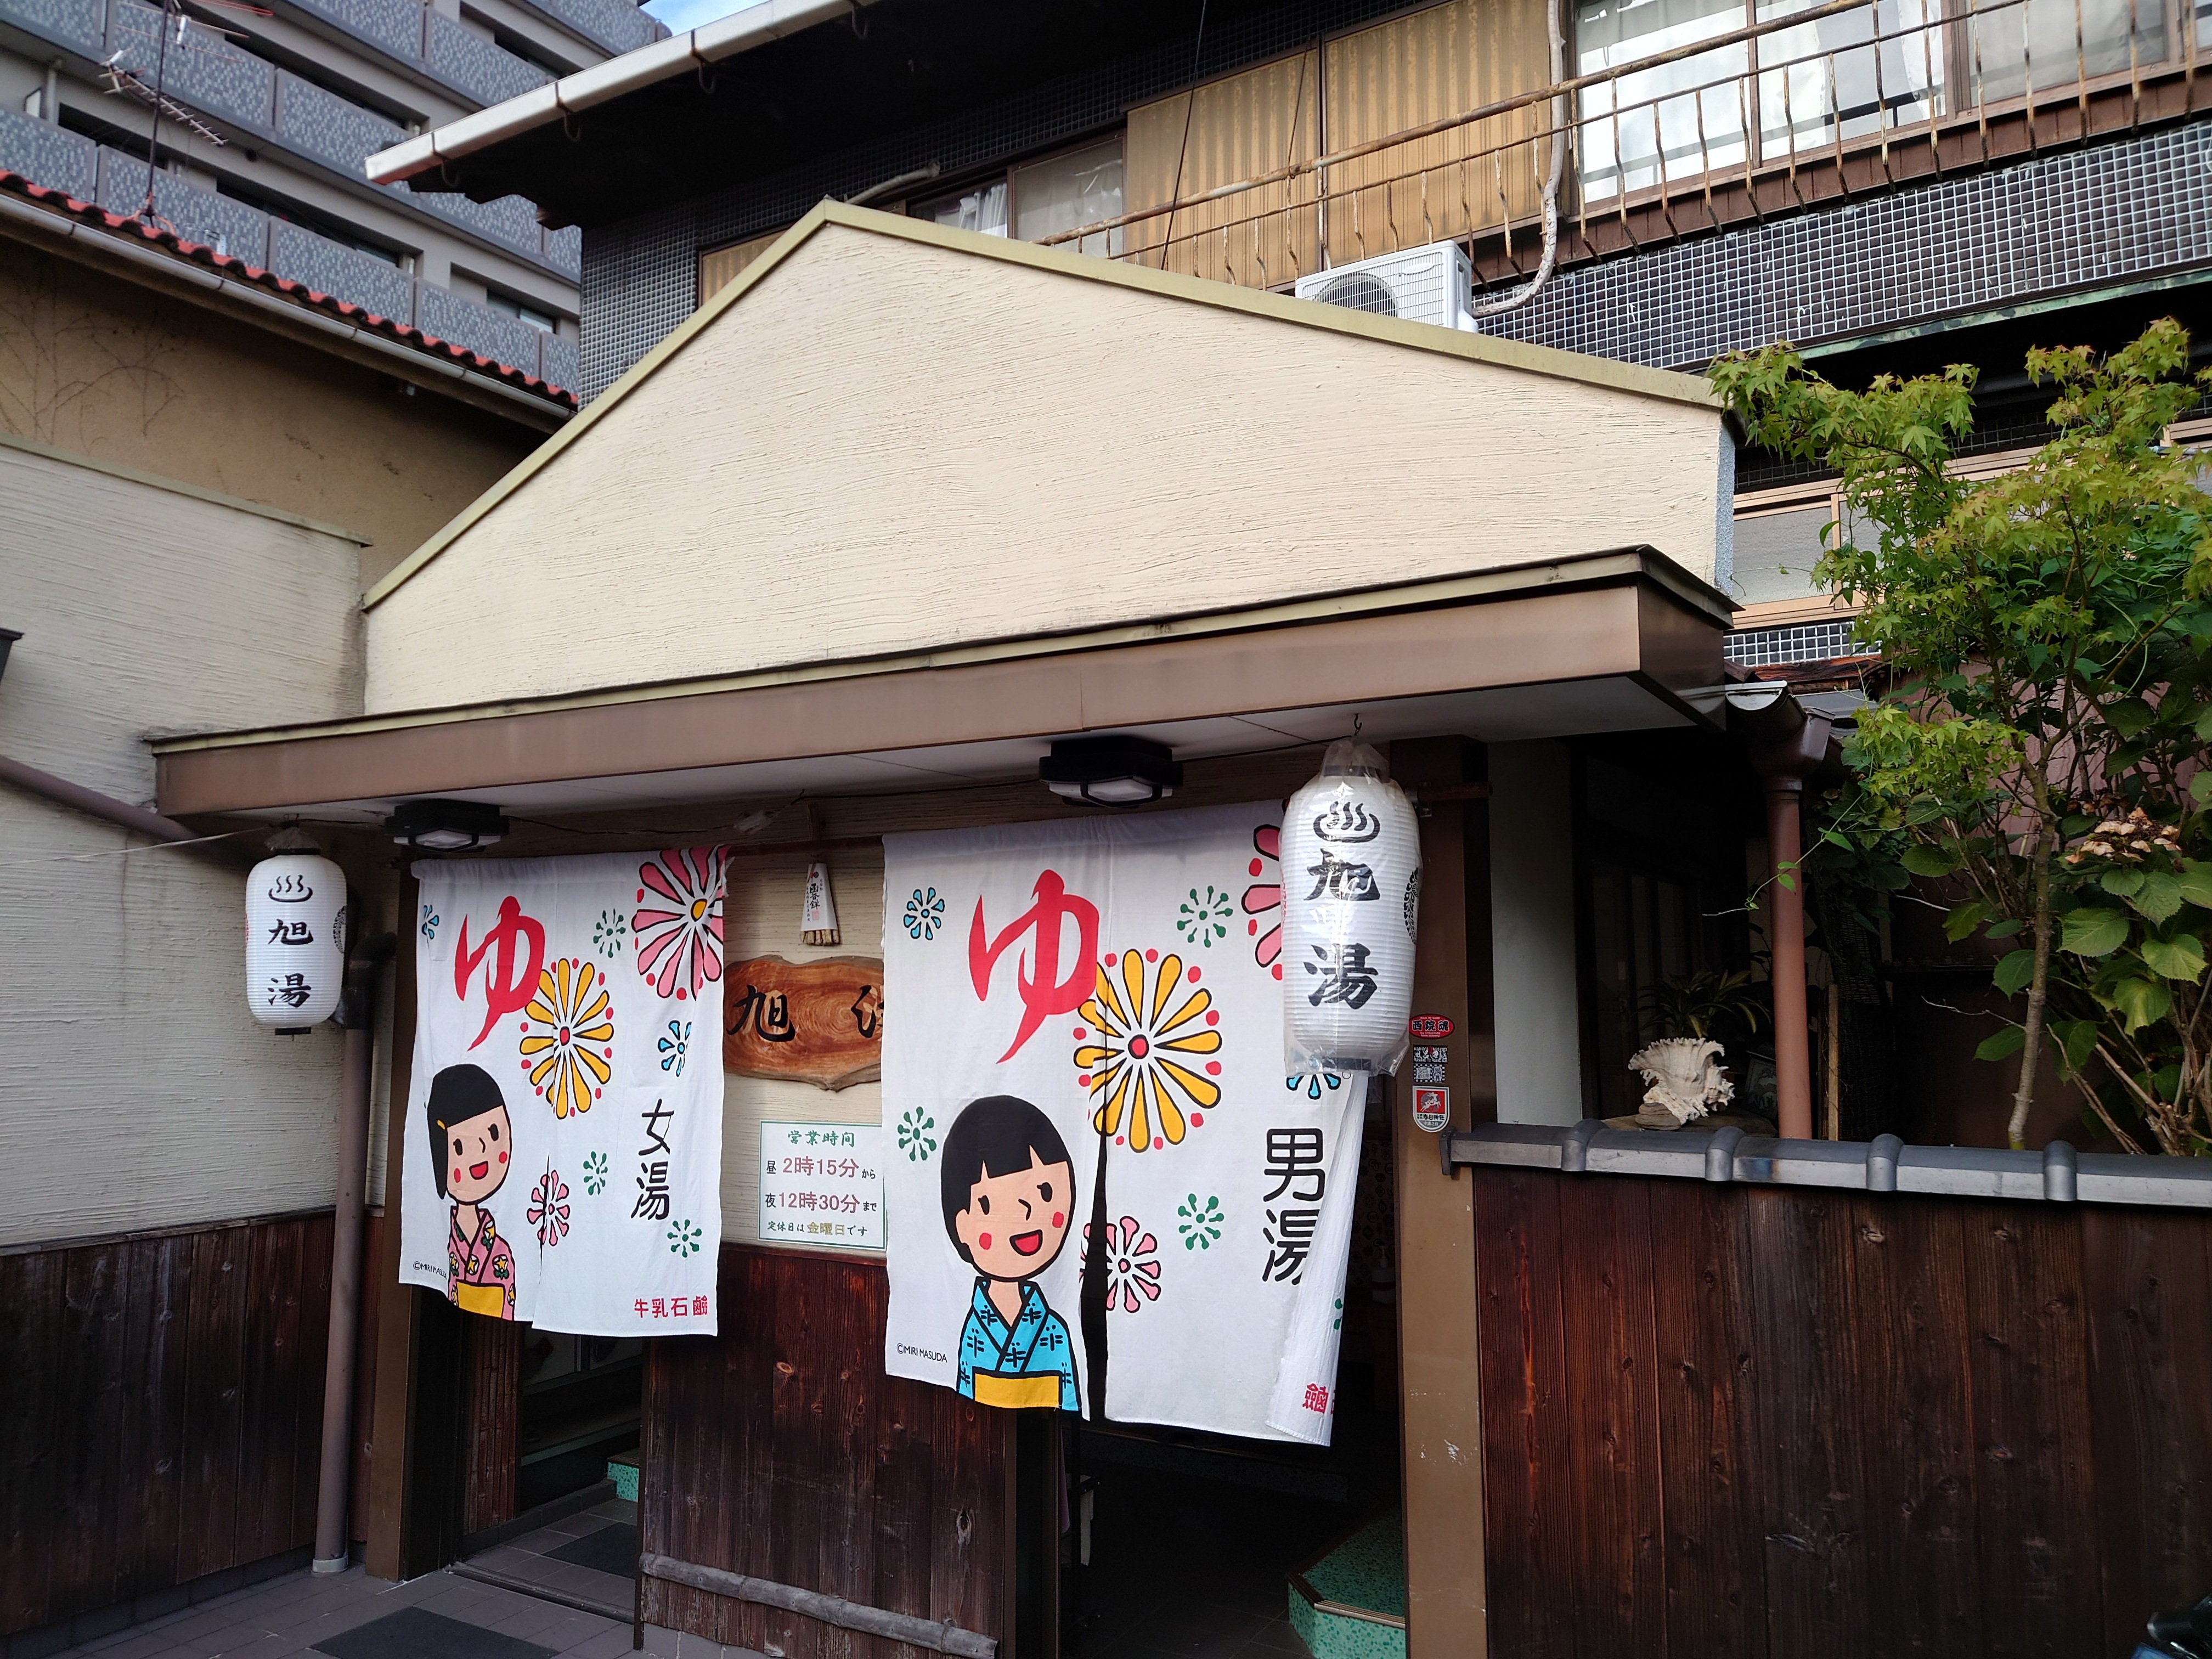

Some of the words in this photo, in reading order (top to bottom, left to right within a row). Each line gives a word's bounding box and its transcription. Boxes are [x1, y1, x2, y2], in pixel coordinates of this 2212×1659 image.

[268, 918, 313, 1008] 旭湯
[454, 895, 545, 1052] ゆ
[969, 868, 1099, 1064] ゆ
[1303, 848, 1381, 1010] 旭湯
[1412, 1019, 1449, 1032] 西院魂
[630, 1098, 675, 1221] 女湯
[788, 1130, 855, 1148] 営業時間
[767, 1221, 868, 1237] 定休日は金曜日です
[1262, 1127, 1326, 1286] 男湯
[919, 1348, 948, 1363] MASUDA
